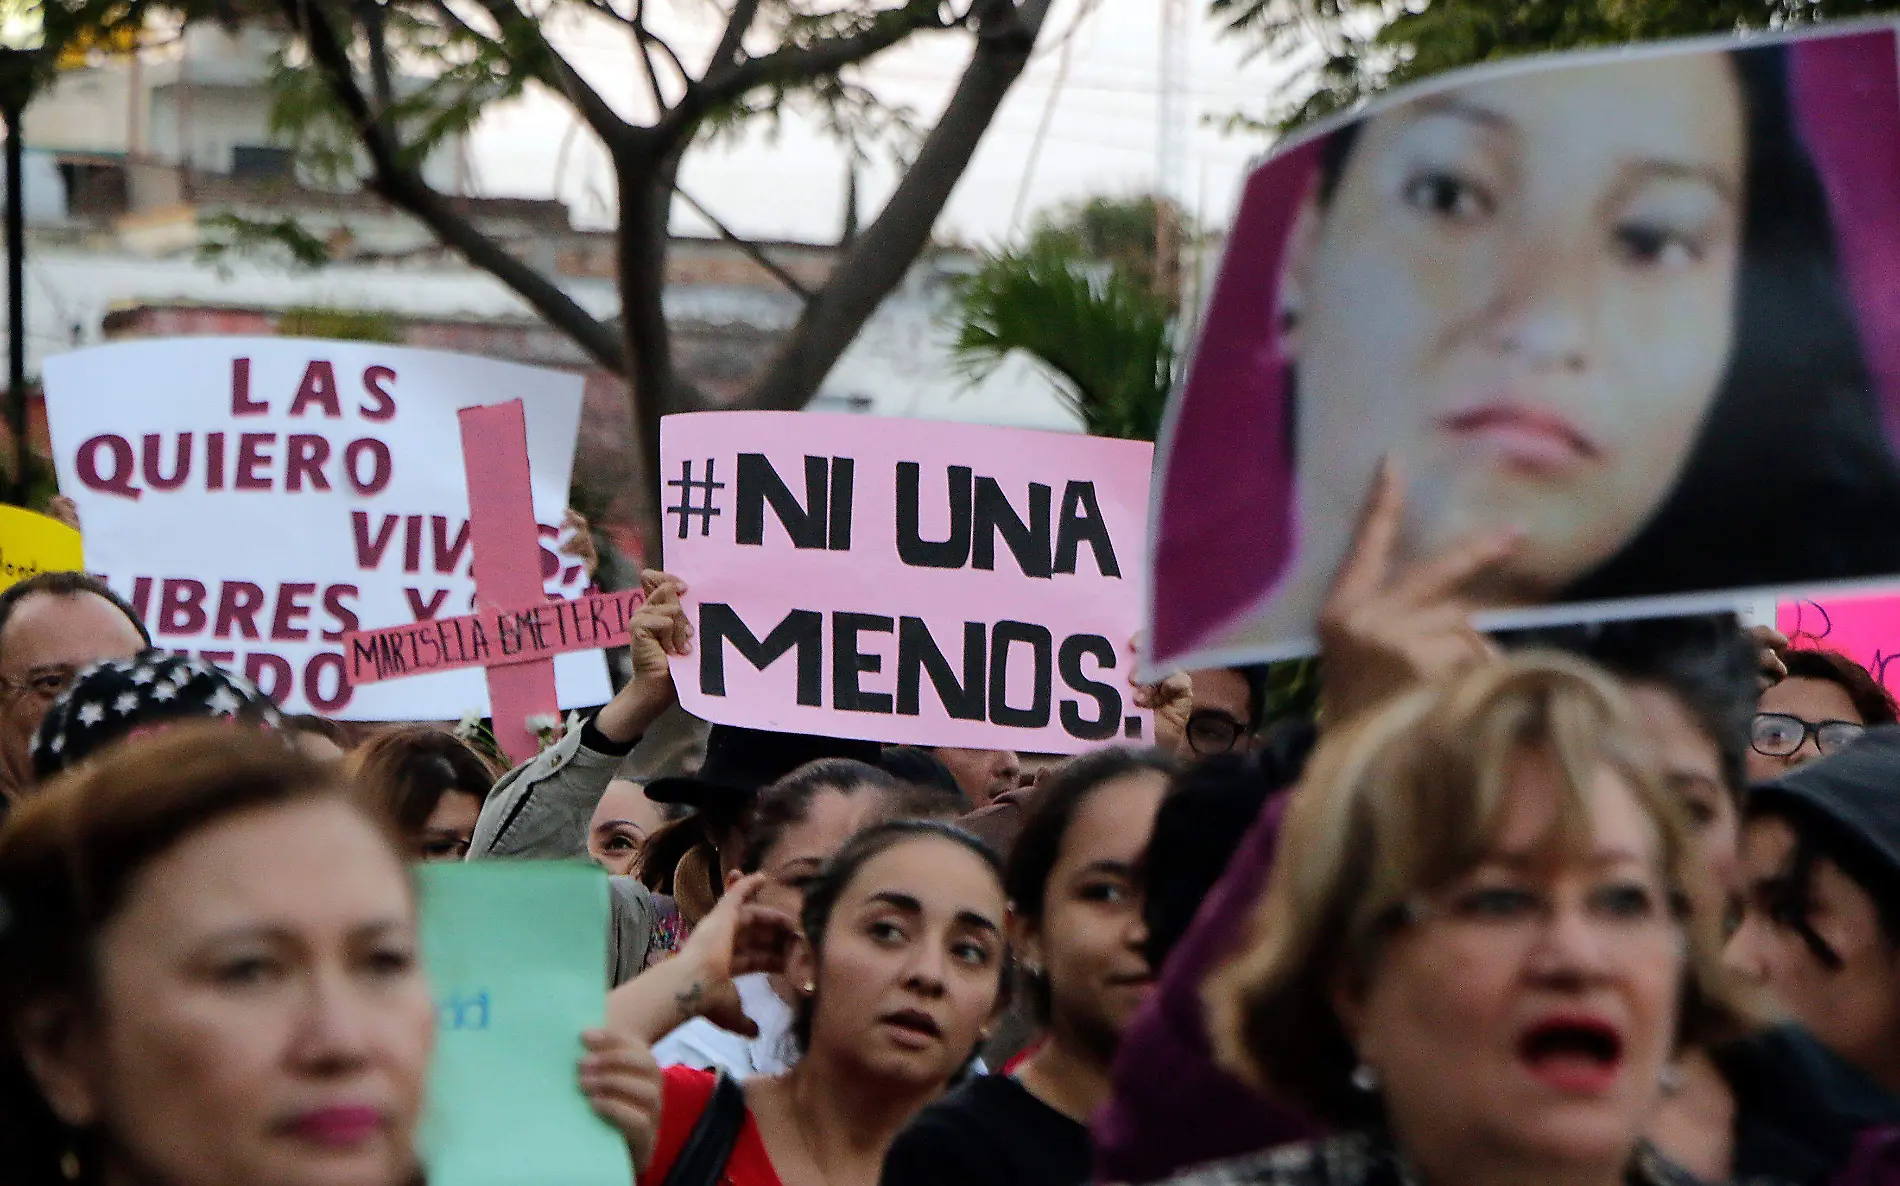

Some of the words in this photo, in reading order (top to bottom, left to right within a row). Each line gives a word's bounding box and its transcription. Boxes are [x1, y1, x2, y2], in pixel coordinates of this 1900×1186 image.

[230, 357, 398, 422] LAS
[75, 432, 392, 500] QUIERO
[351, 511, 582, 585] VIVS,
[667, 453, 854, 551] #NI
[896, 461, 1122, 579] UNA
[93, 575, 360, 642] IBRES
[699, 602, 1142, 741] MENOS.
